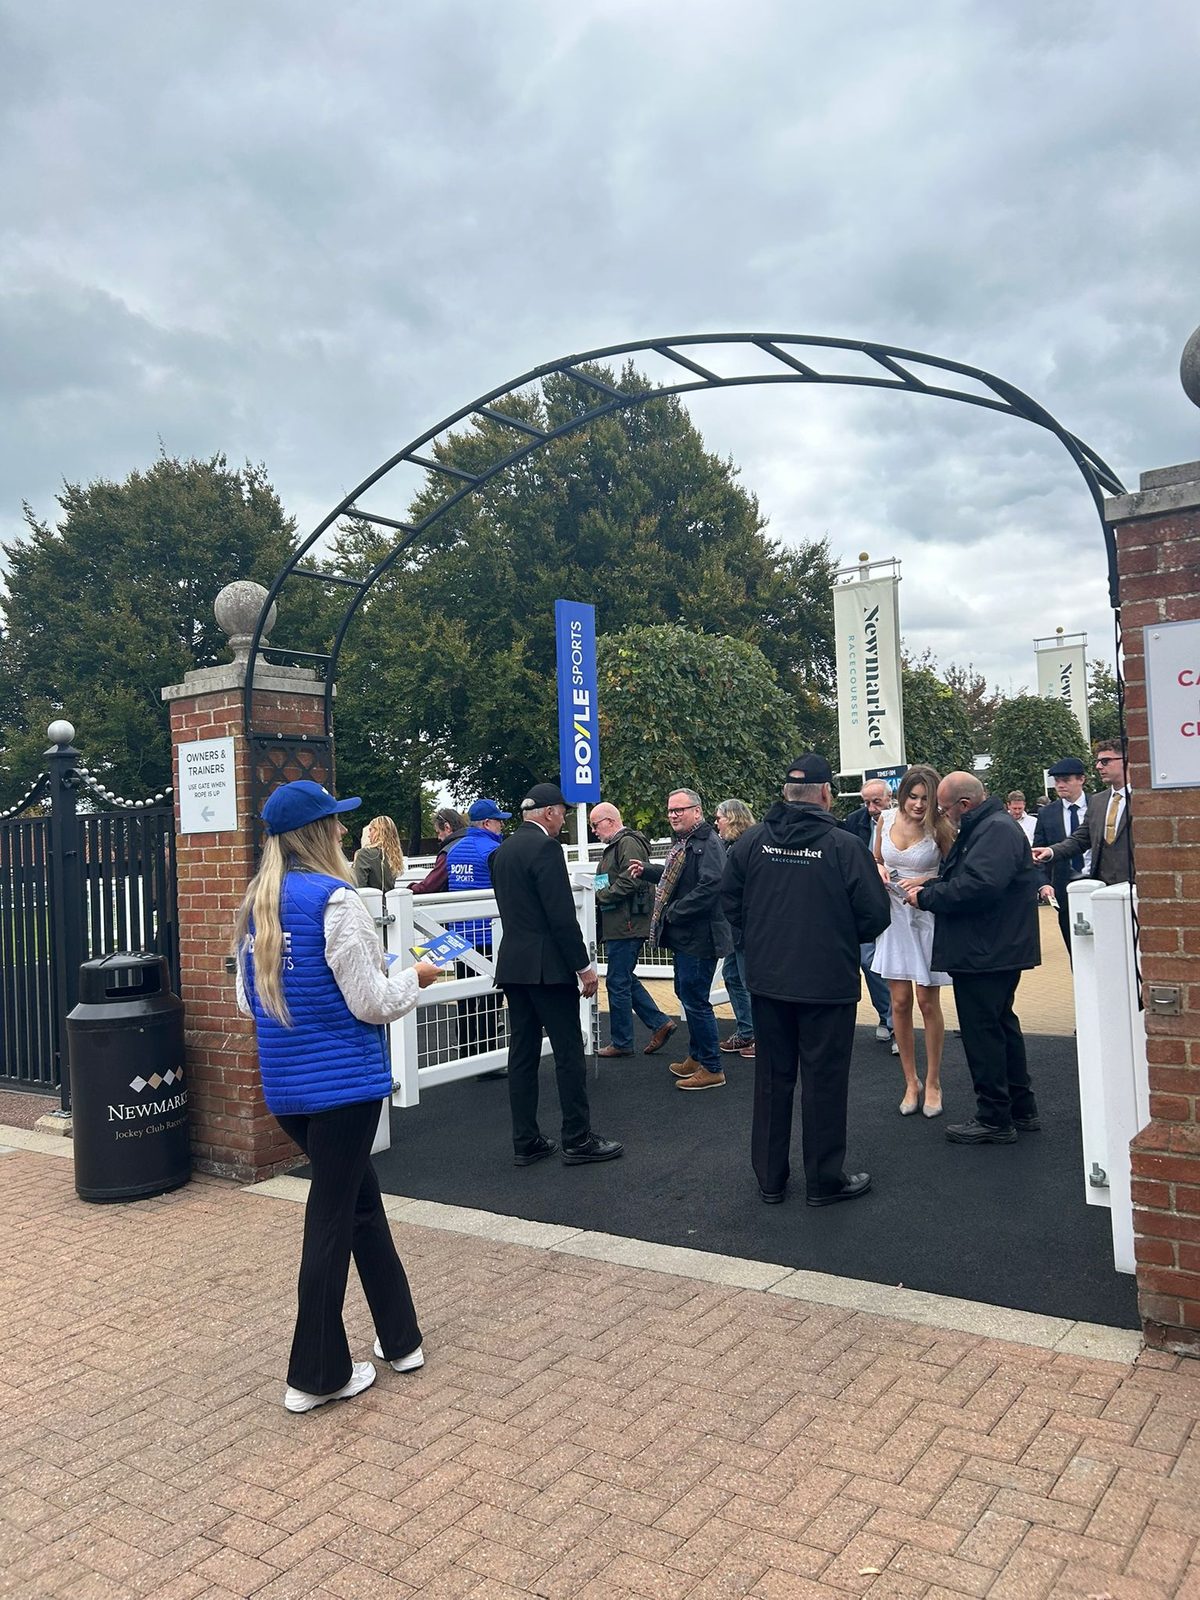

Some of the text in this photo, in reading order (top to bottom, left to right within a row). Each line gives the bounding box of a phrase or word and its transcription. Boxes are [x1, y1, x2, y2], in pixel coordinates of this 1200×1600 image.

[848, 635, 859, 726] RACECOURSES
[863, 604, 886, 749] Newmarket
[571, 620, 593, 784] BOYLE SPORTS
[186, 750, 226, 762] OWNERS &
[188, 764, 225, 776] TRAINERS
[762, 844, 823, 858] Newmarket
[771, 857, 810, 865] RACECOURSES
[451, 864, 474, 874] BOYLE
[115, 1123, 165, 1140] Jockey Club
